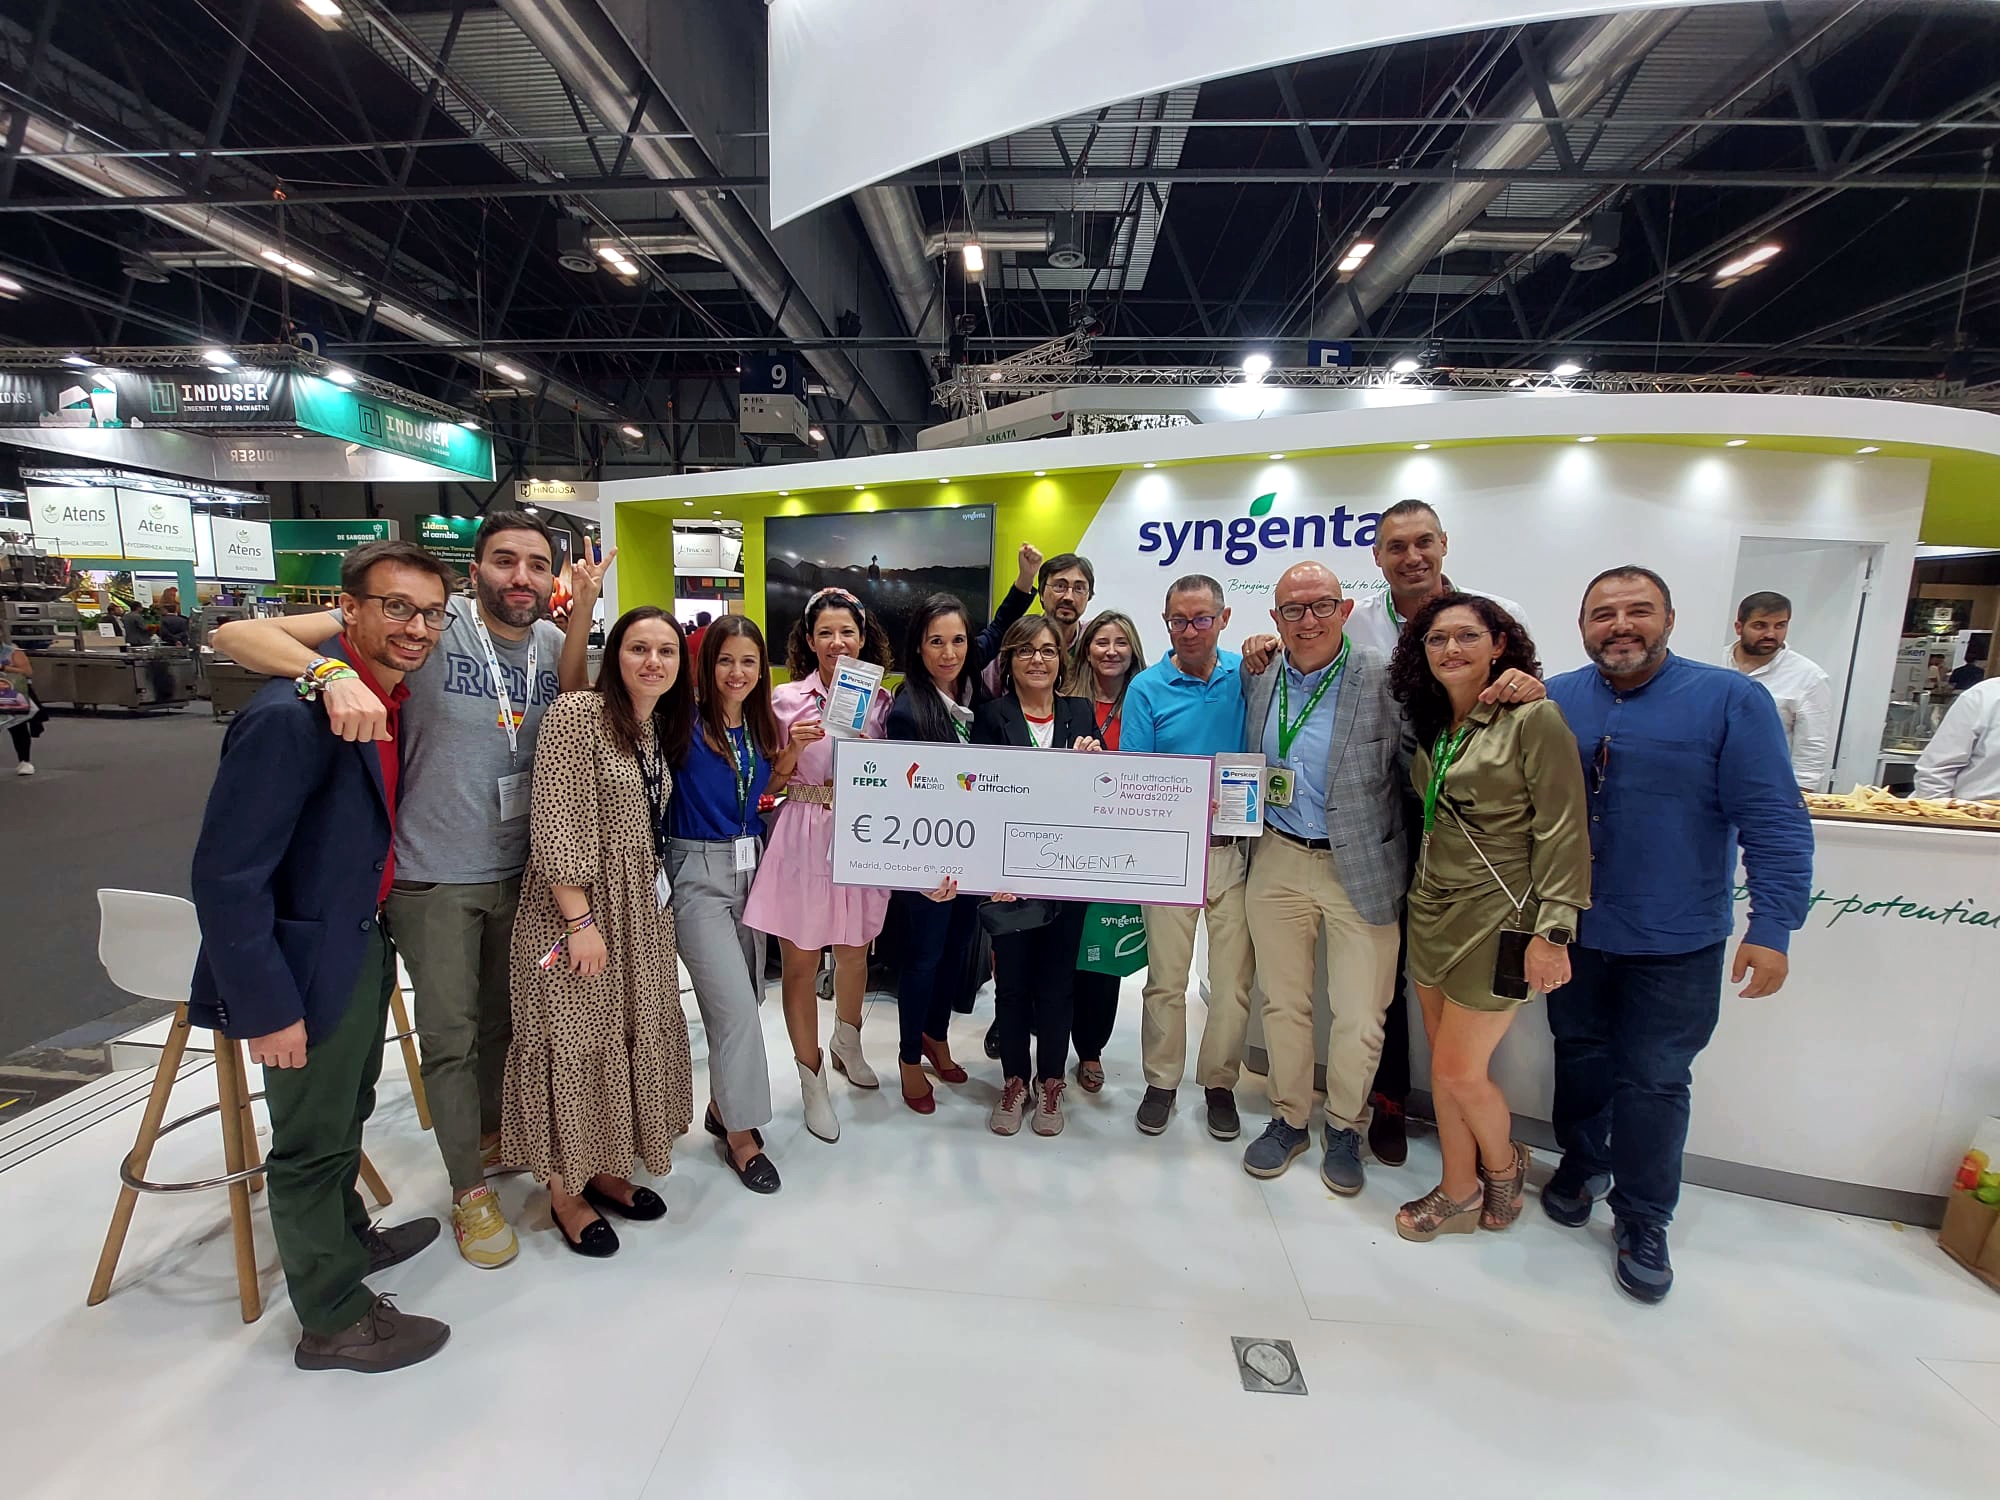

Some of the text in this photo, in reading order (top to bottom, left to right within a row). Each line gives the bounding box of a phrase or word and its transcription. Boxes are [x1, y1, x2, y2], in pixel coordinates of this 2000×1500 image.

[771, 364, 787, 389] 9
[181, 384, 269, 402] INDUSER
[802, 376, 808, 400] 9
[385, 414, 449, 449] INDUSER
[986, 429, 1017, 444] SAKATA
[533, 486, 576, 495] HINOJOSA
[62, 506, 106, 522] Atens
[138, 519, 180, 535] Atens
[422, 530, 460, 540] el cambio
[1138, 505, 1382, 567] syngenta
[228, 543, 262, 557] Atens
[1227, 578, 1271, 595] Bringing
[852, 776, 888, 788] FEPEX
[977, 773, 1030, 795] fruit attraction
[1120, 772, 1188, 784] fruit attraction
[913, 783, 945, 791] MADRID
[1120, 782, 1193, 794] InnovationHub
[1119, 791, 1180, 802] Awards2022
[1093, 806, 1173, 818] F&V INDUSTRY
[851, 814, 976, 850] € 2,000
[1010, 828, 1064, 842] Company:
[849, 860, 882, 871] Madrid,
[884, 862, 921, 873] October
[940, 866, 964, 875] 2022
